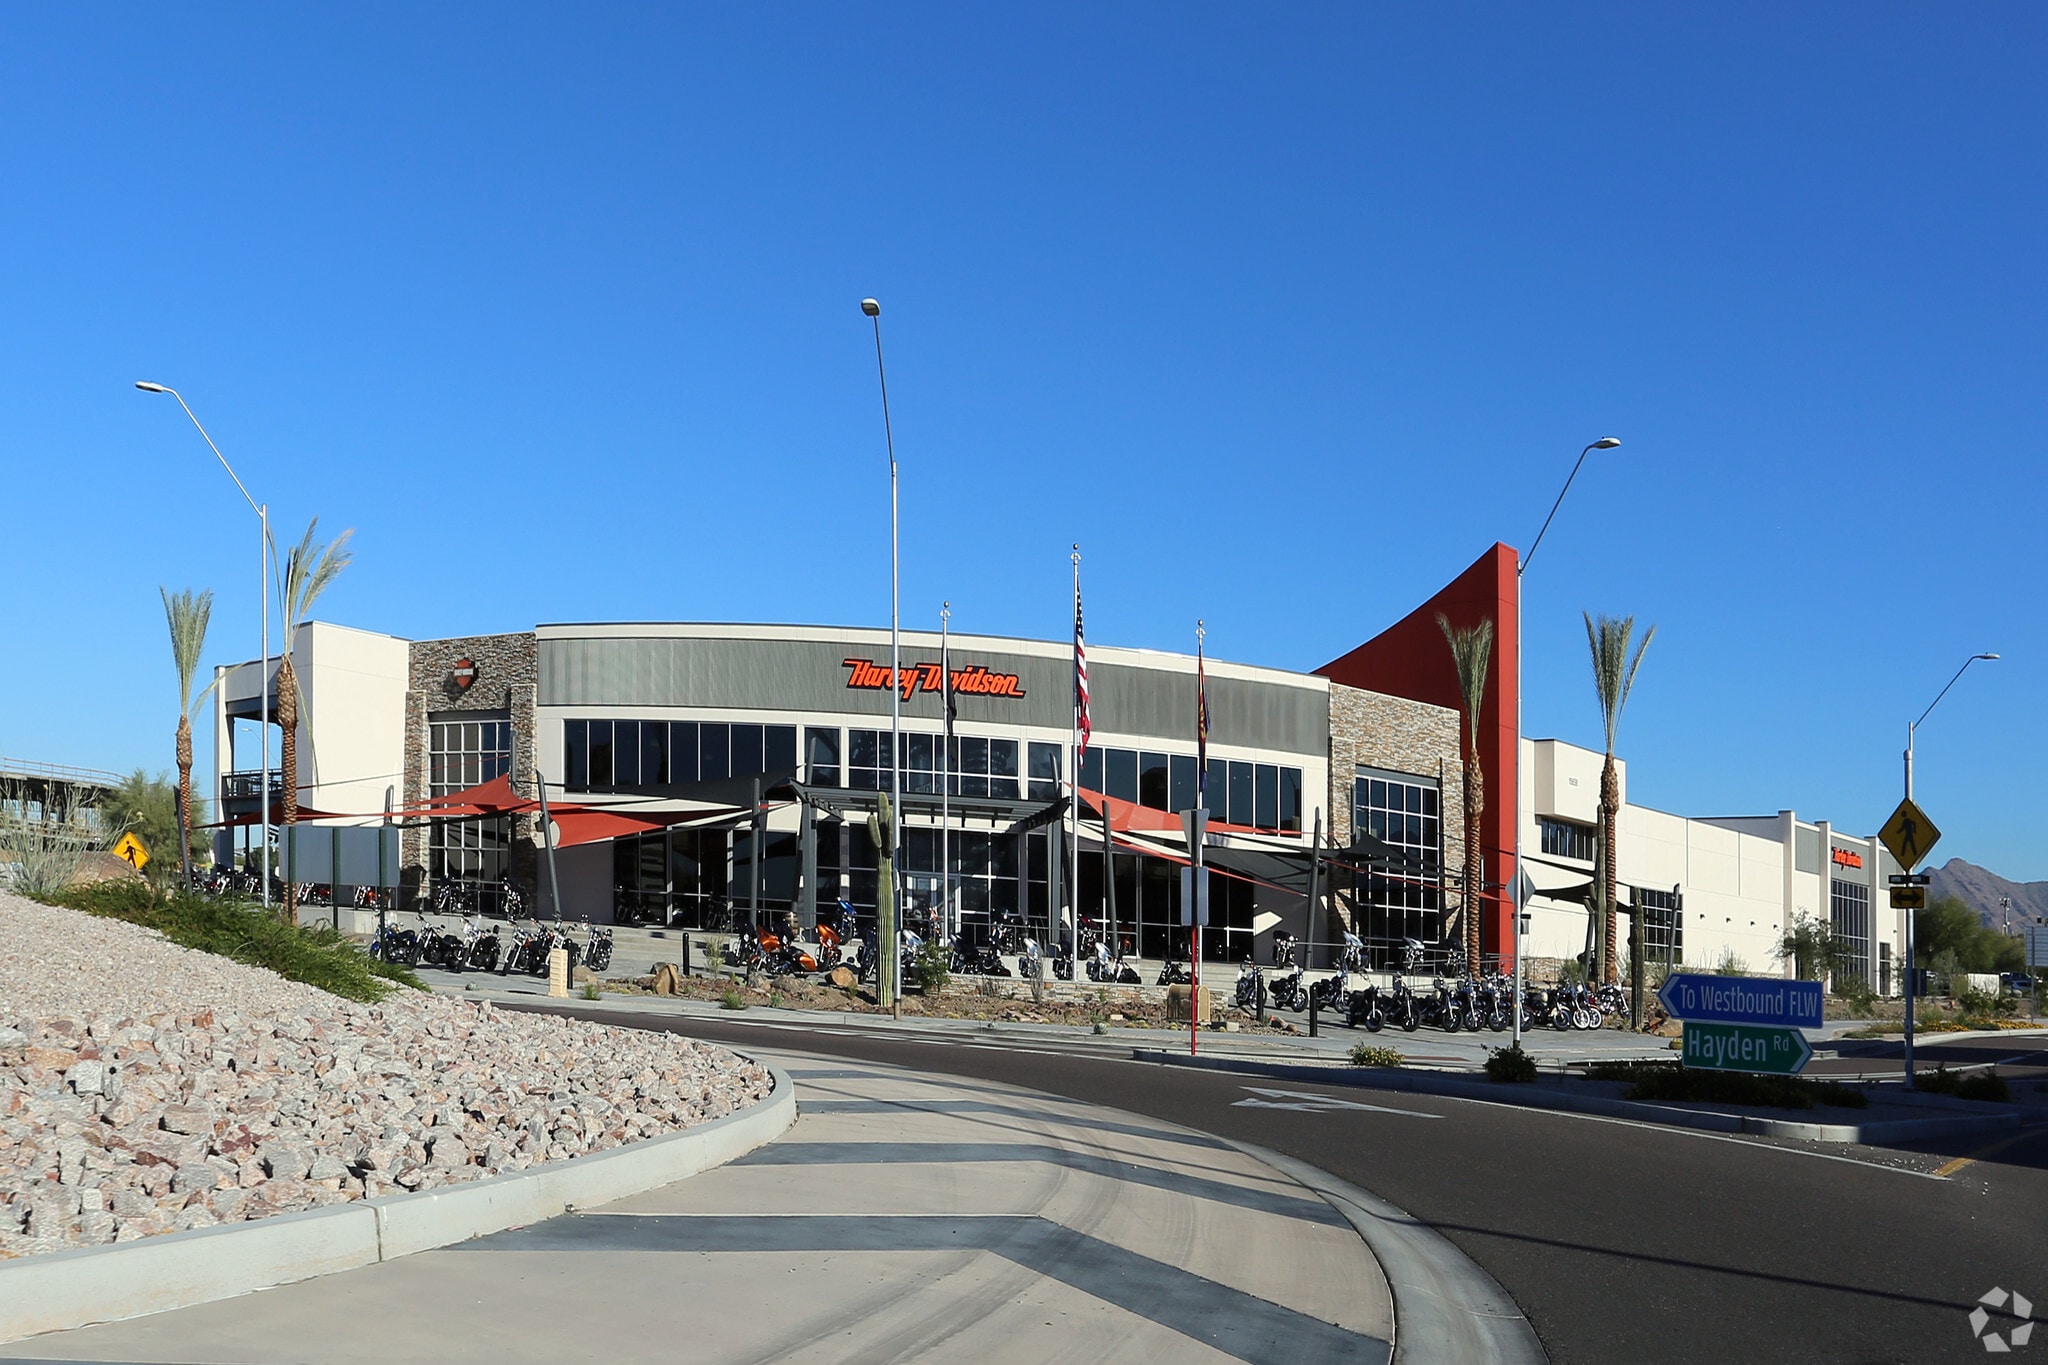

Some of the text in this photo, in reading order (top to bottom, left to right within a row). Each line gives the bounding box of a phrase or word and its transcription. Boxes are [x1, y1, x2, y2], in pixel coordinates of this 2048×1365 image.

[843, 659, 1026, 701] Harley-Dvidson
[1680, 984, 1818, 1017] To Westbound FLW
[1688, 1029, 1789, 1066] Hayden Rd
